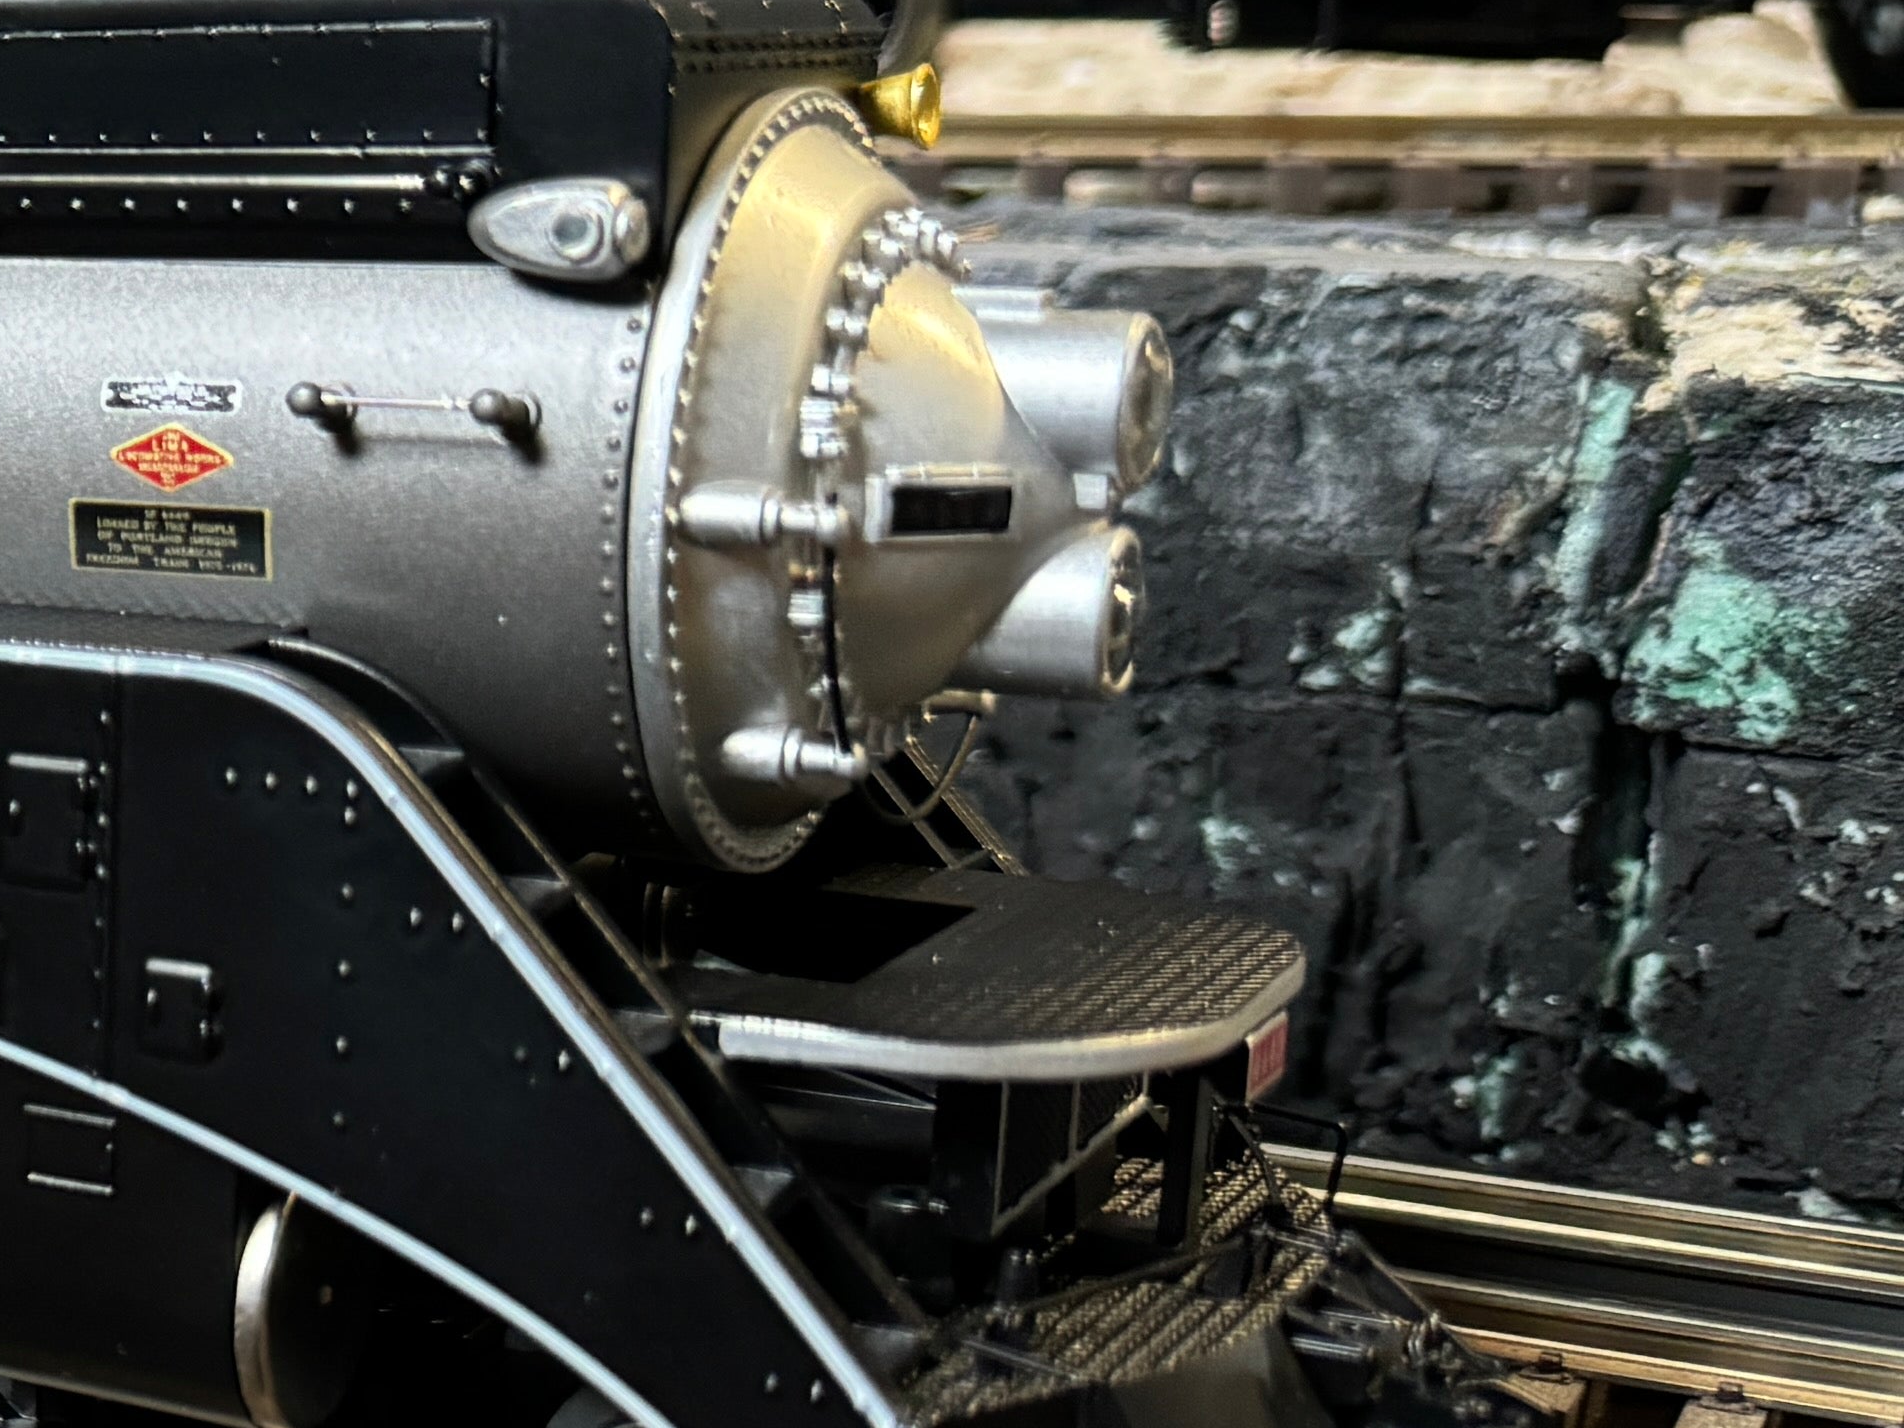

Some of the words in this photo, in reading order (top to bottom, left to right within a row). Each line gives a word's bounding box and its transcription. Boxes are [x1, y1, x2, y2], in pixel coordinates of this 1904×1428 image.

[144, 521, 158, 531] BY
[165, 522, 187, 533] THE
[193, 523, 236, 535] PEOPLE
[97, 530, 113, 541] OF
[121, 531, 182, 544] PORTLAND
[108, 542, 122, 553] TO
[132, 543, 154, 555] THE
[164, 546, 222, 558] AMERICAN
[86, 553, 139, 565] FREEDOM
[153, 555, 190, 568] TRAIN
